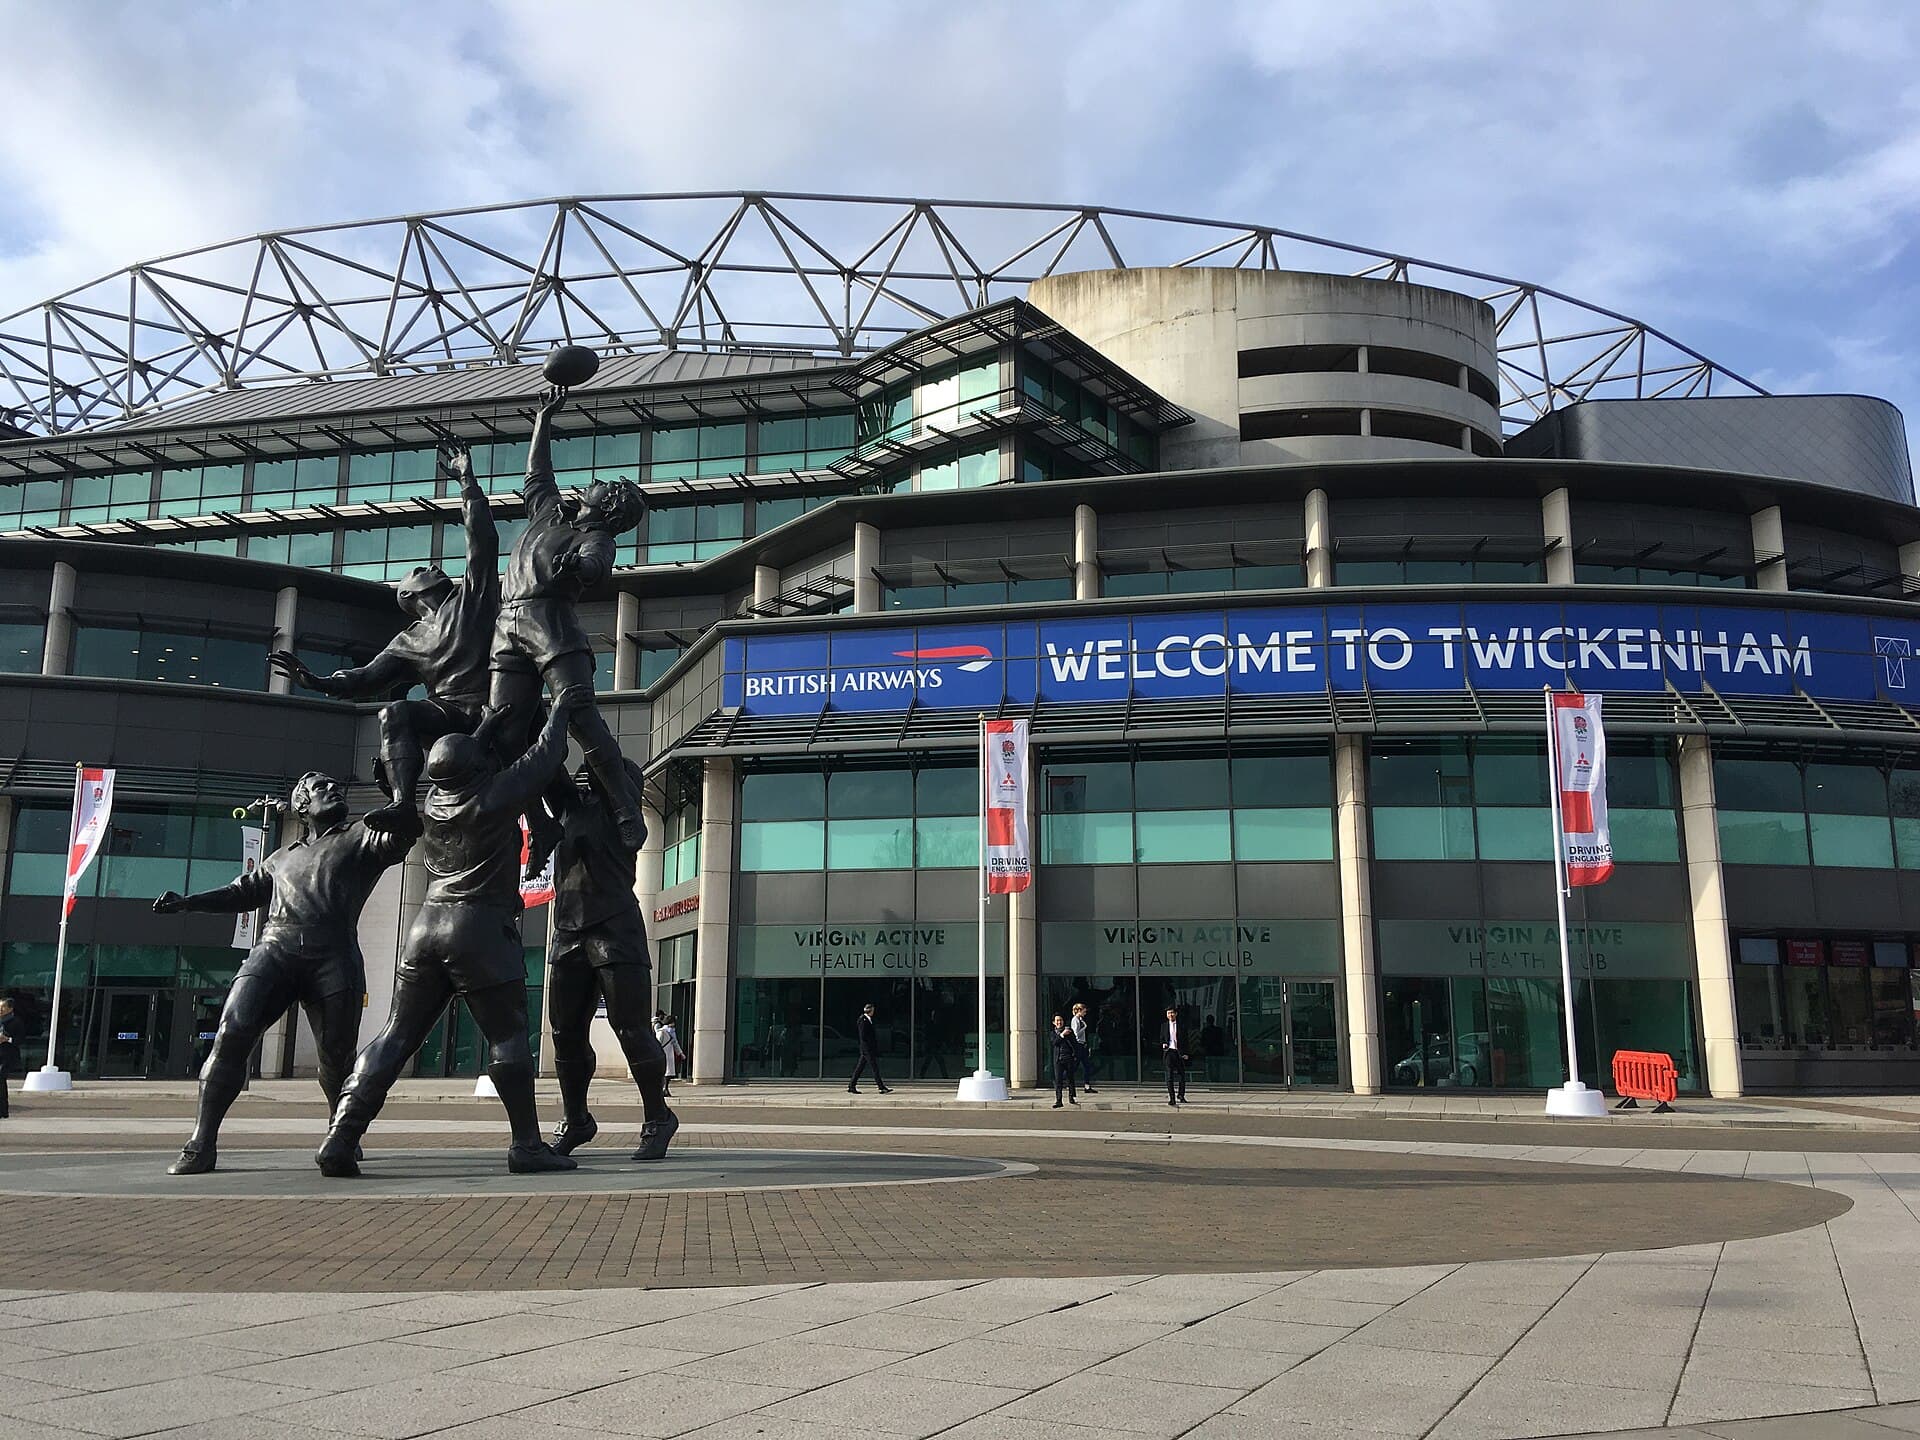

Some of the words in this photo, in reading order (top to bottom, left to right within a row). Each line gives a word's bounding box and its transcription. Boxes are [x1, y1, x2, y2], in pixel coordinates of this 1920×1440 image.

[1046, 630, 1317, 683] WELCOME
[1331, 627, 1413, 671] TO
[1428, 626, 1813, 677] TWICKENHAM
[745, 673, 836, 697] BRITISH
[841, 668, 943, 692] AIRWAYS
[1569, 843, 1611, 855] DRIVING
[1570, 853, 1612, 862] ENGLAND'S
[991, 857, 1028, 866] DRIVING
[794, 930, 866, 947] VIRGIN
[874, 929, 945, 945] ACTIVE
[1103, 927, 1184, 944] VIRGIN
[1192, 926, 1271, 943] ACTIVE
[1448, 926, 1534, 944] VIRGIN
[810, 953, 875, 969] HEALTH
[882, 952, 929, 969] CLUB
[1122, 951, 1194, 967] HEALTH
[1202, 951, 1253, 967] CLUB
[1469, 952, 1545, 969] HATH
